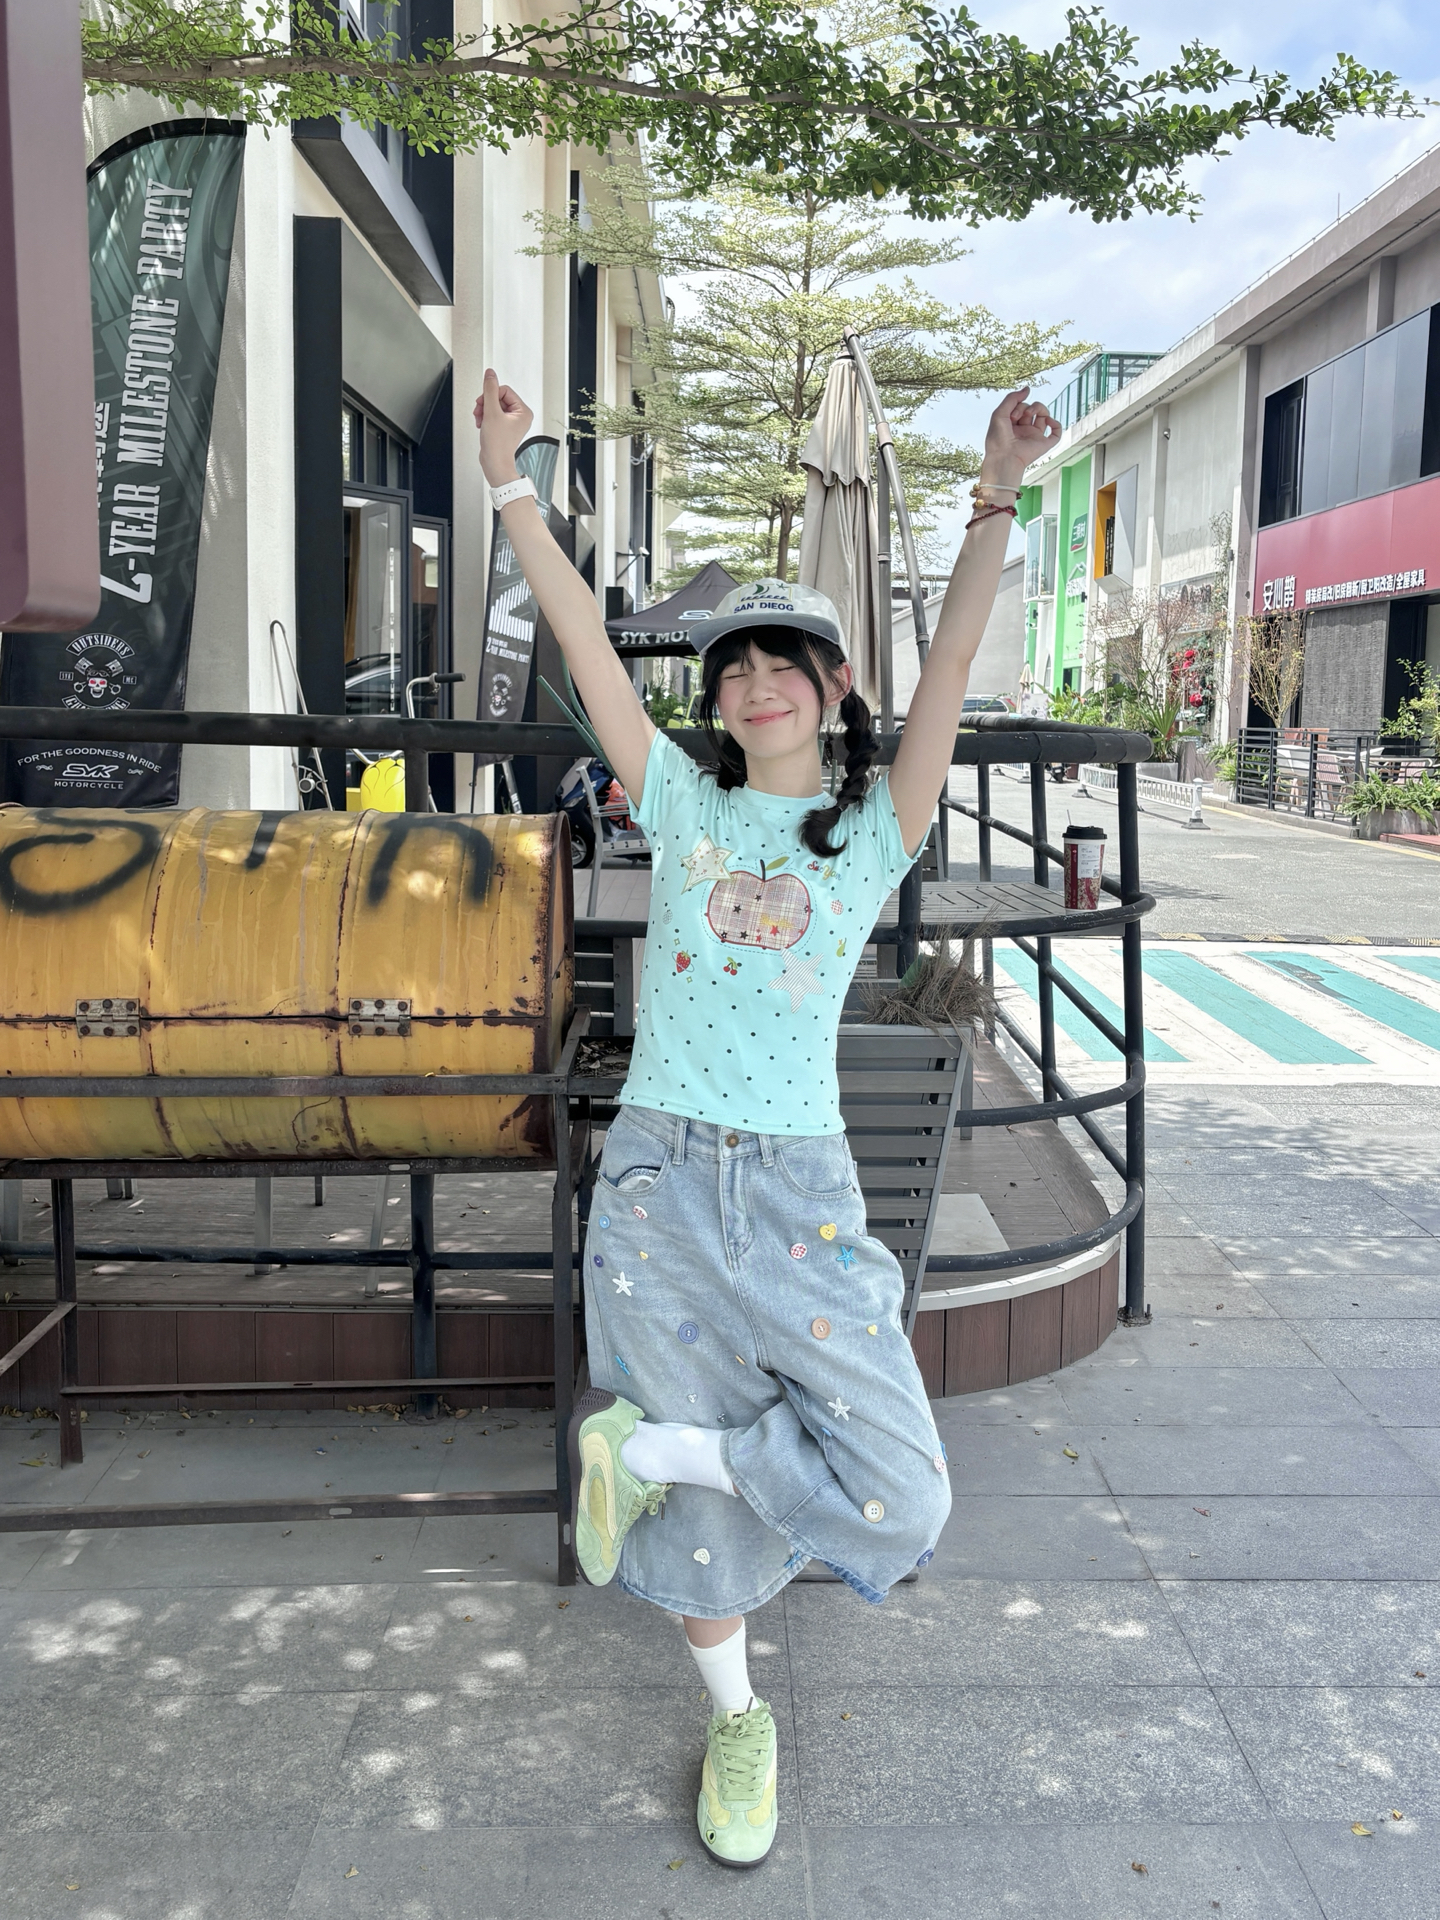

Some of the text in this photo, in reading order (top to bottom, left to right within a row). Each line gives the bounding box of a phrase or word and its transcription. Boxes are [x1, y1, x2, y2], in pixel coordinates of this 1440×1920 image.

[136, 178, 193, 280] PARTY
[116, 294, 180, 467] MILESTONE
[733, 602, 755, 614] SAN
[71, 634, 130, 656] OUTSIDERS
[619, 631, 652, 645] SYK
[17, 747, 162, 773] FOR THE GOODNESS IN RIDE
[62, 763, 119, 778] SYK
[54, 781, 124, 790] MOTORCYCLE
